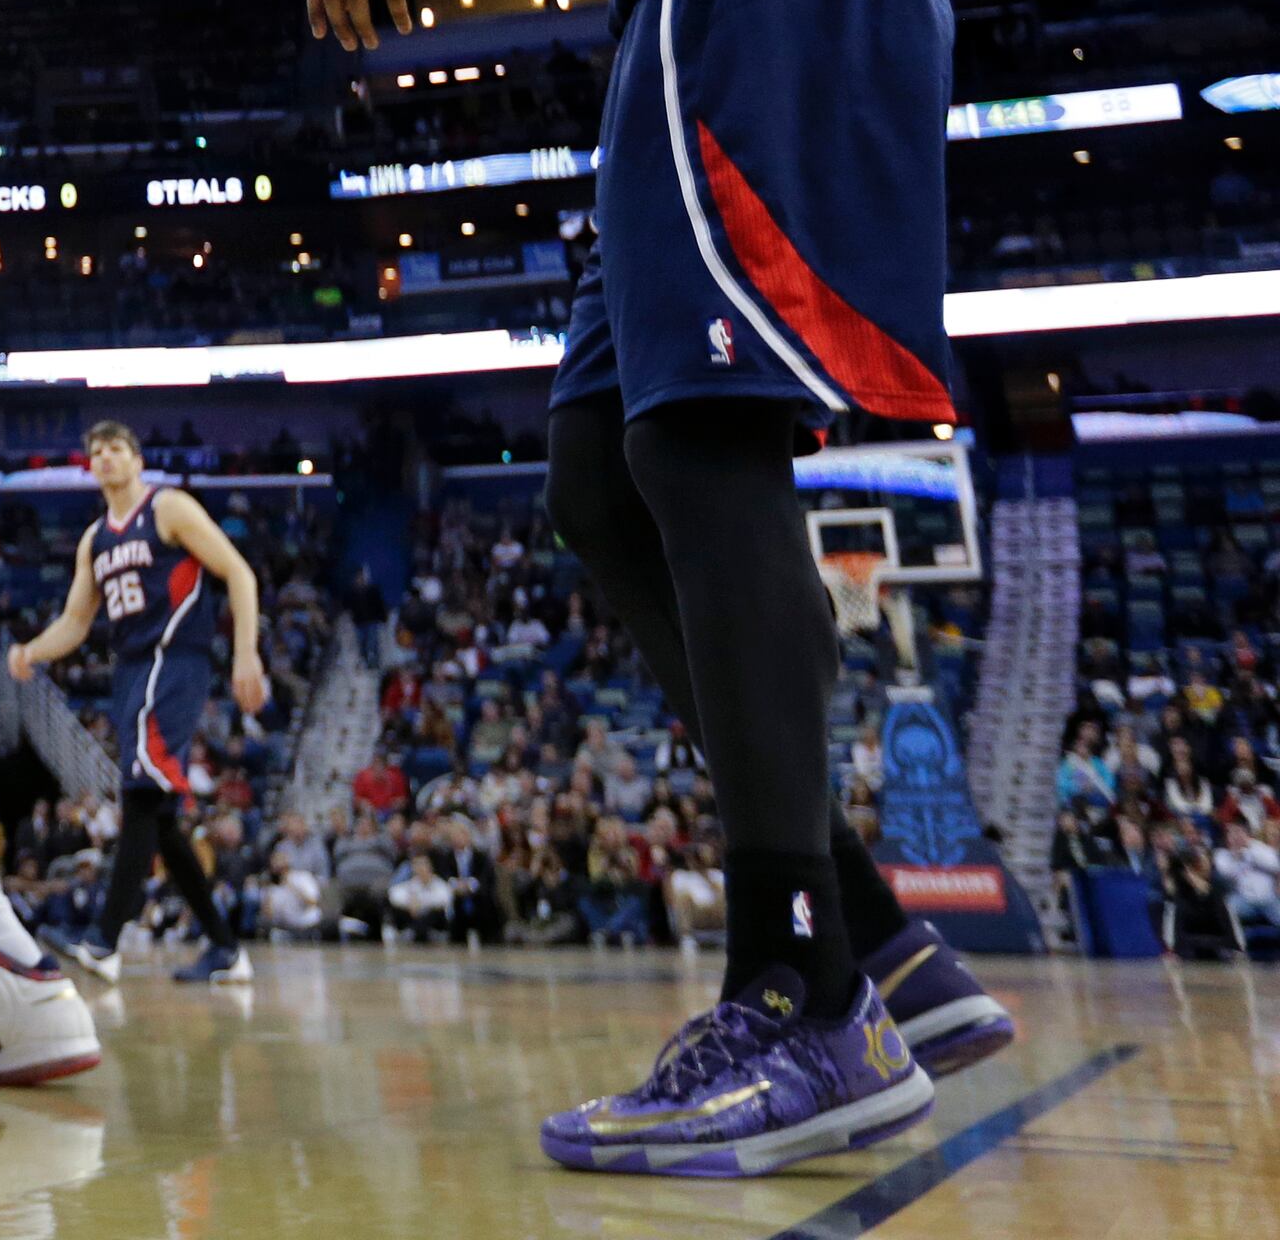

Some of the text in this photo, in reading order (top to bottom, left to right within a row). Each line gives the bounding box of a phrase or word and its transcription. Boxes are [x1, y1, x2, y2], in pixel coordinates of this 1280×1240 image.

[60, 183, 78, 209] 0
[147, 175, 273, 206] STEALS 0
[104, 570, 146, 621] 26
